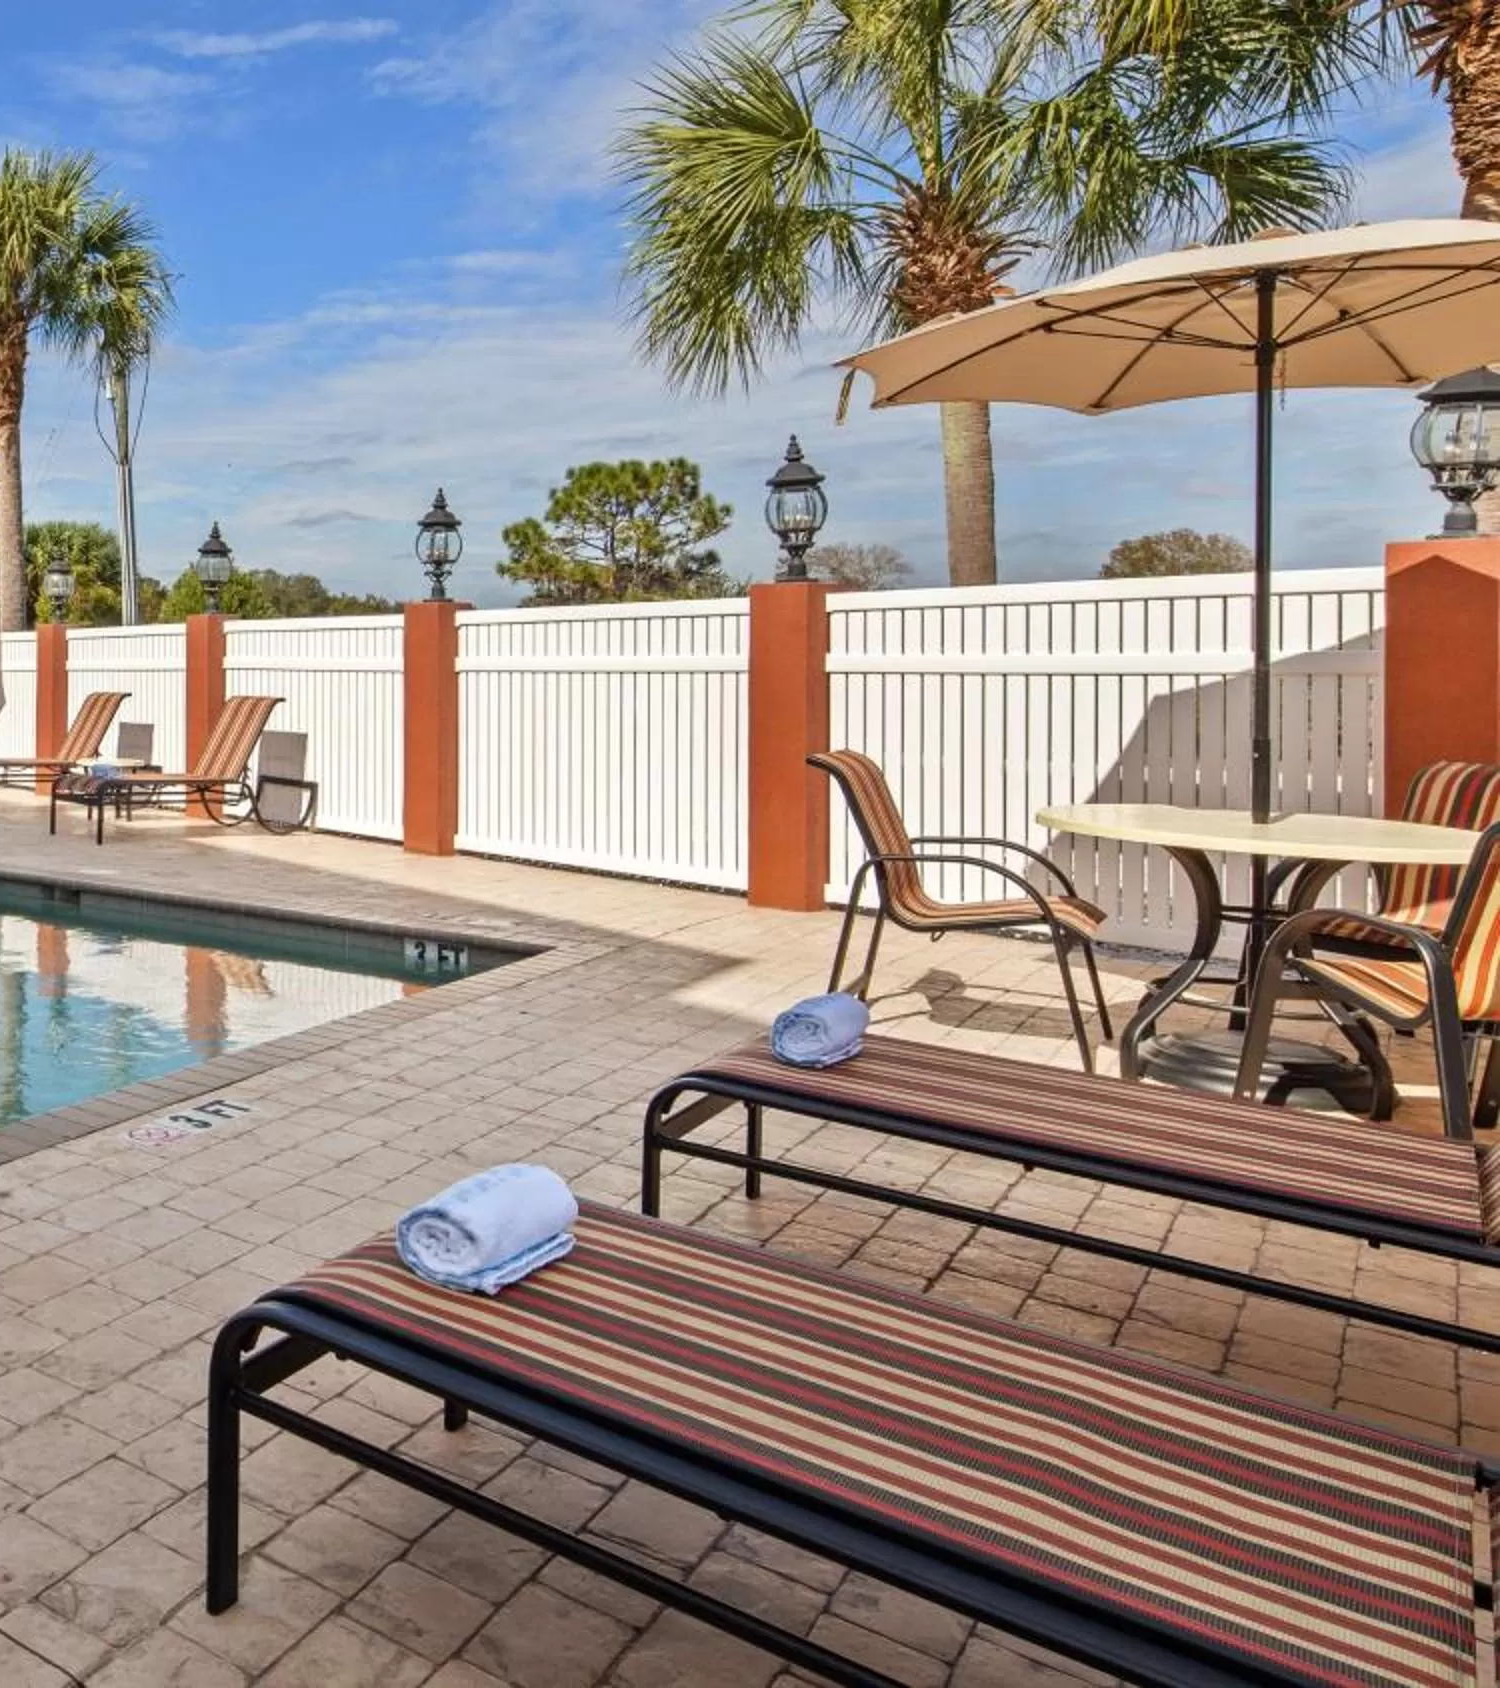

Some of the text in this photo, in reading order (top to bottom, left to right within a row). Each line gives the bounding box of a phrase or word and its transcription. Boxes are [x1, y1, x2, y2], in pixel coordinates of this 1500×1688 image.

[437, 943, 466, 966] FT
[169, 1099, 252, 1130] 3 FT
